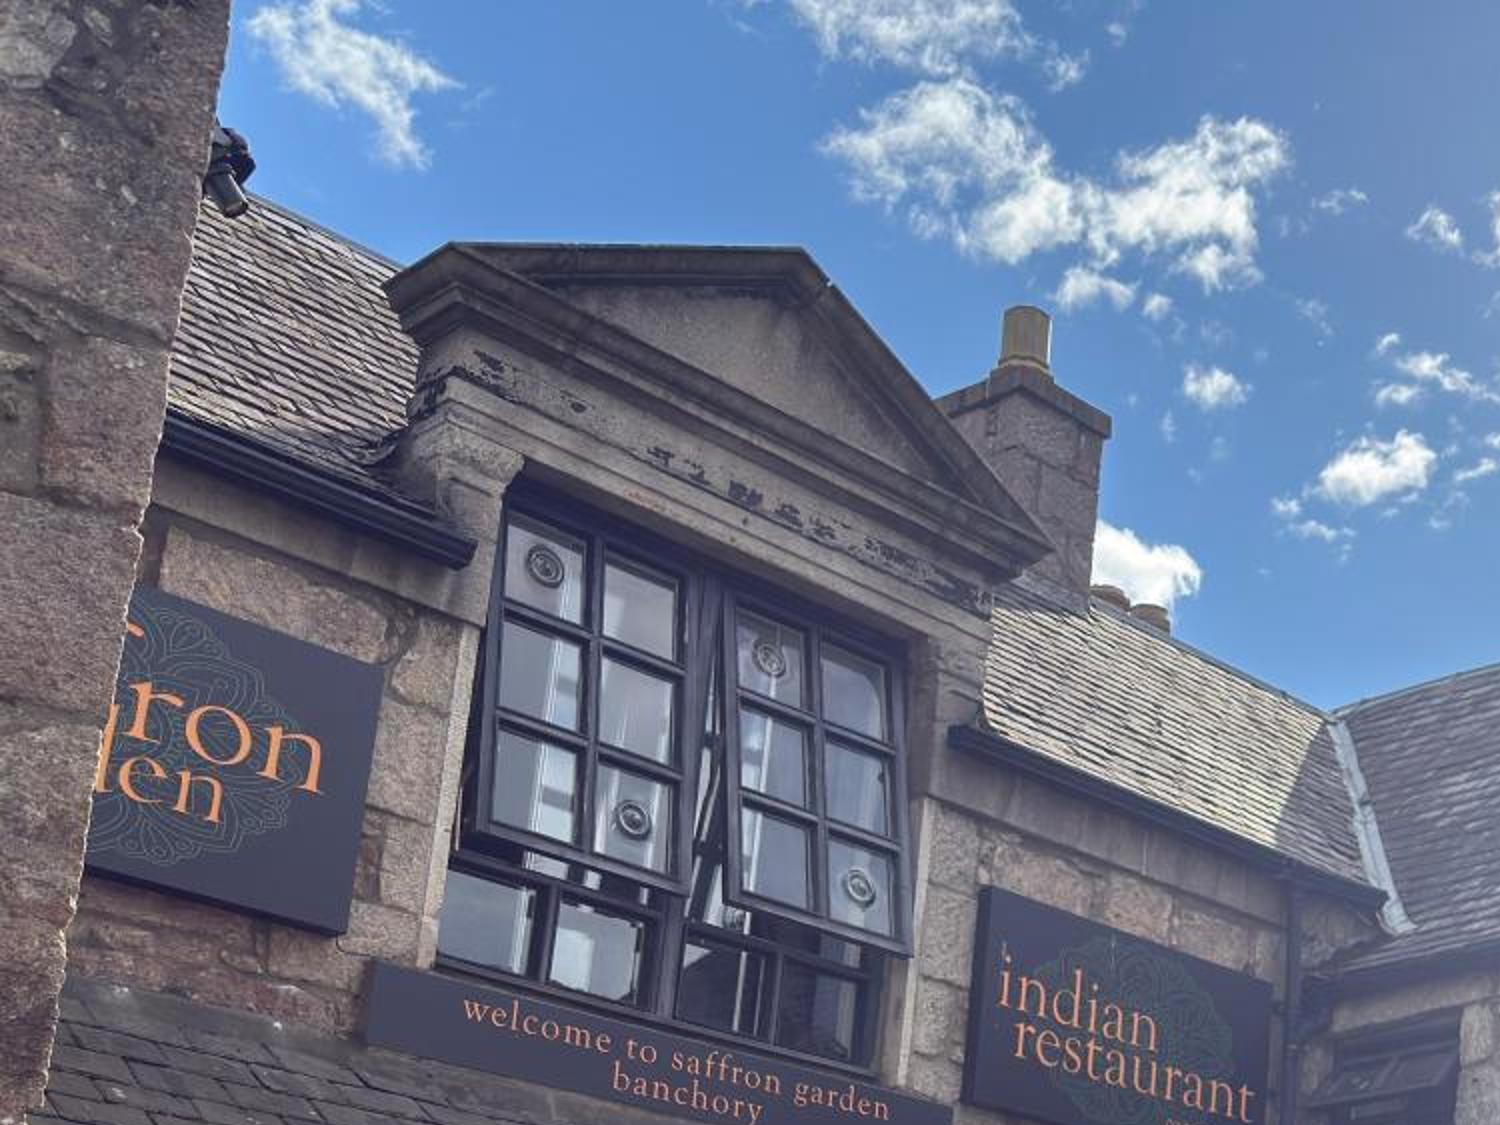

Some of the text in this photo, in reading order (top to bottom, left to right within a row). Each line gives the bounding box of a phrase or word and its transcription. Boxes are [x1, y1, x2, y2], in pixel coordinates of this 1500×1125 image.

[998, 953, 1161, 1051] indian
[463, 998, 892, 1122] welcome to saffron garden
[1014, 1022, 1256, 1123] restaurant
